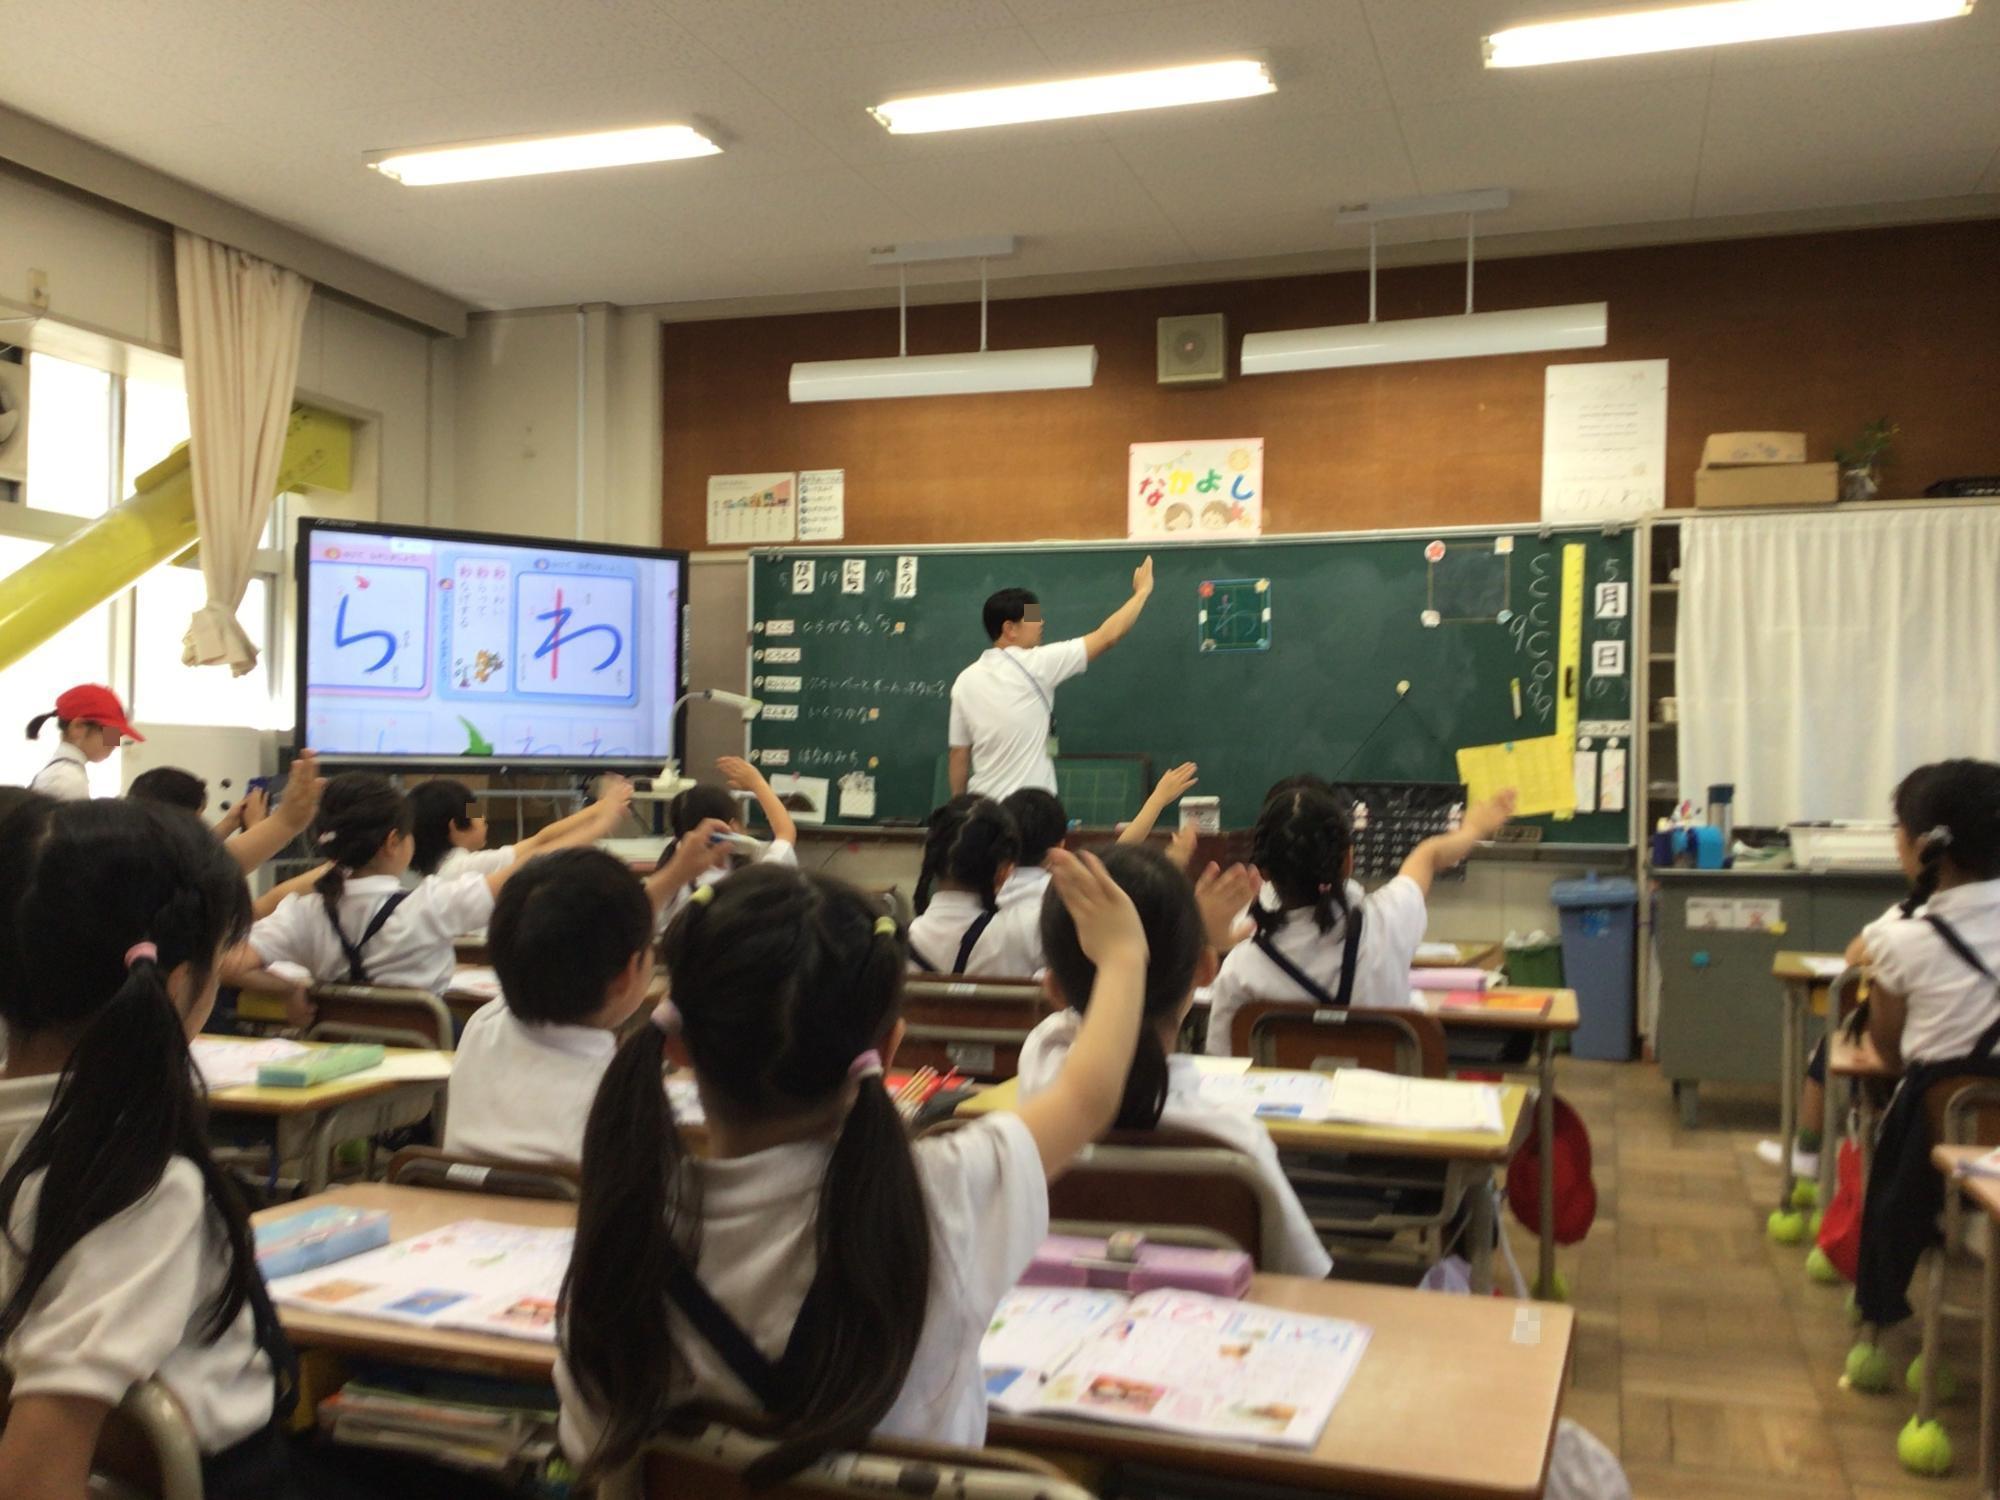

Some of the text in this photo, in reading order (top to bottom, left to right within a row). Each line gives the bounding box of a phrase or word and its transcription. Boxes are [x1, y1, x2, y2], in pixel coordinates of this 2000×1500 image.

[1138, 468, 1255, 508] なかよし
[1596, 585, 1620, 617] 月
[335, 574, 397, 674] ら
[533, 587, 624, 682] わ
[1598, 646, 1617, 668] 日
